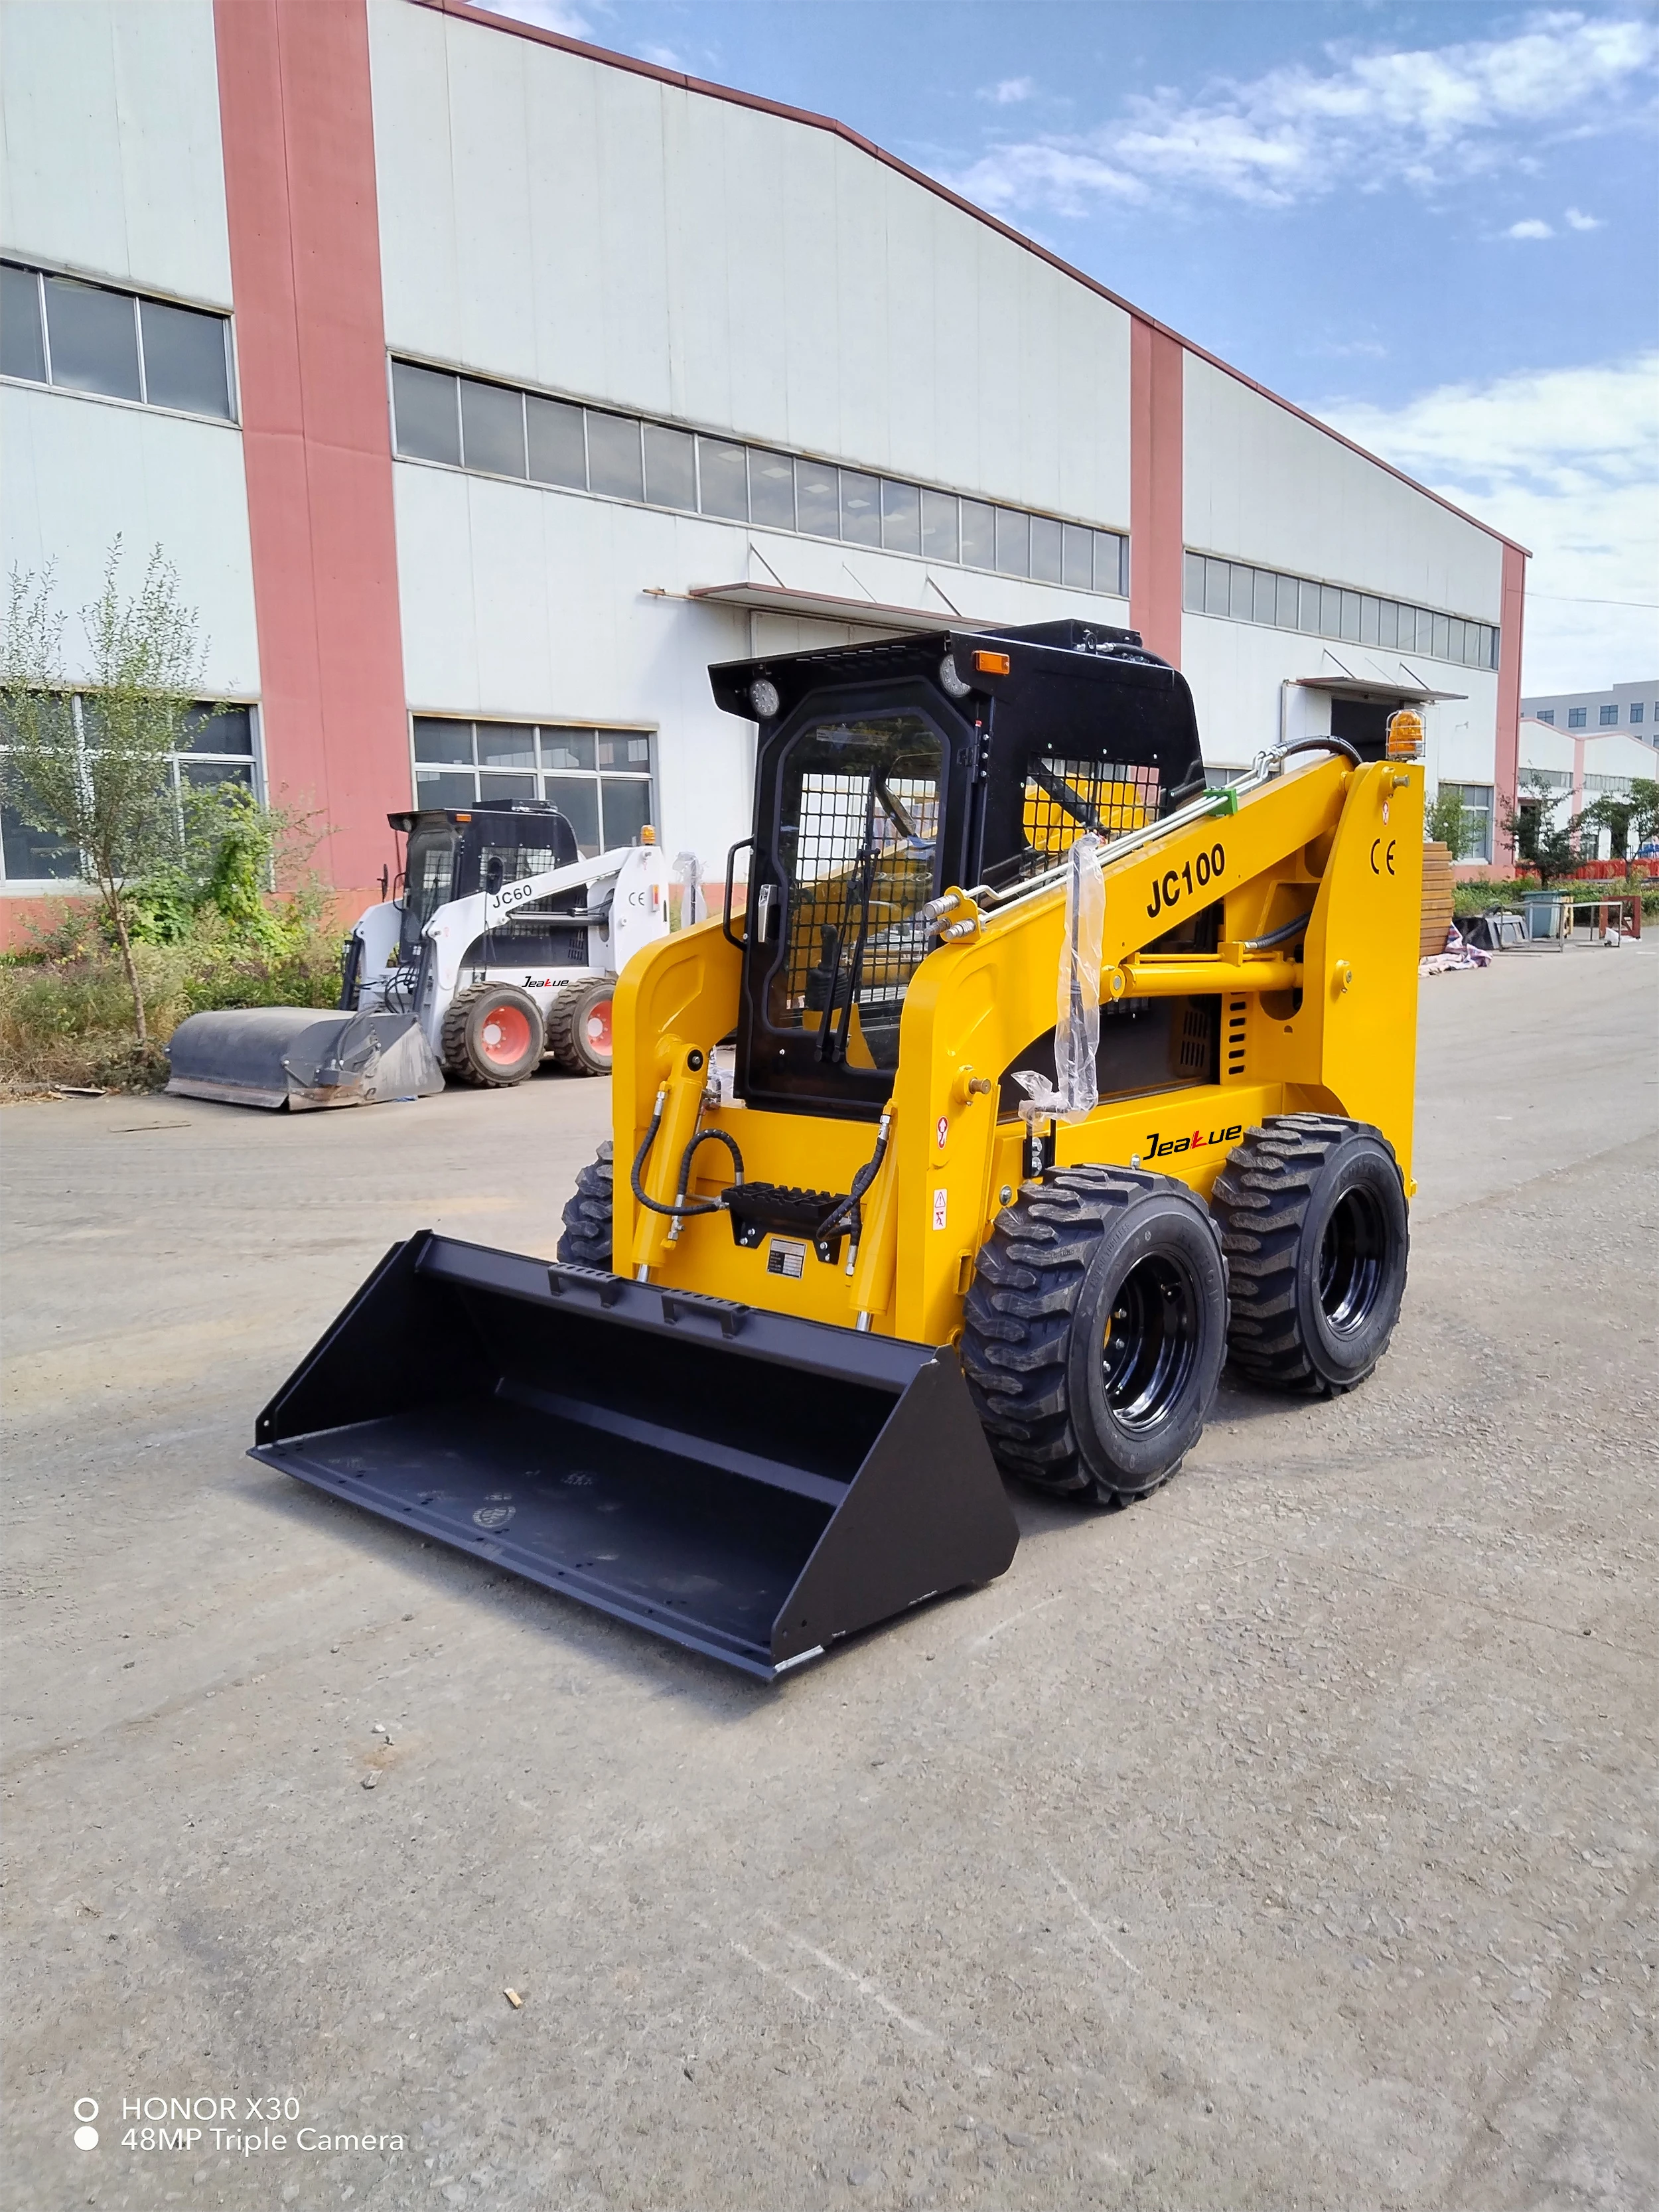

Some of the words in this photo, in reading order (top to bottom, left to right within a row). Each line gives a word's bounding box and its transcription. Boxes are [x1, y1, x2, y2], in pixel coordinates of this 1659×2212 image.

[1370, 838, 1396, 876] CE
[1147, 843, 1225, 919] JC100
[493, 885, 532, 909] JC60
[628, 892, 645, 907] CE
